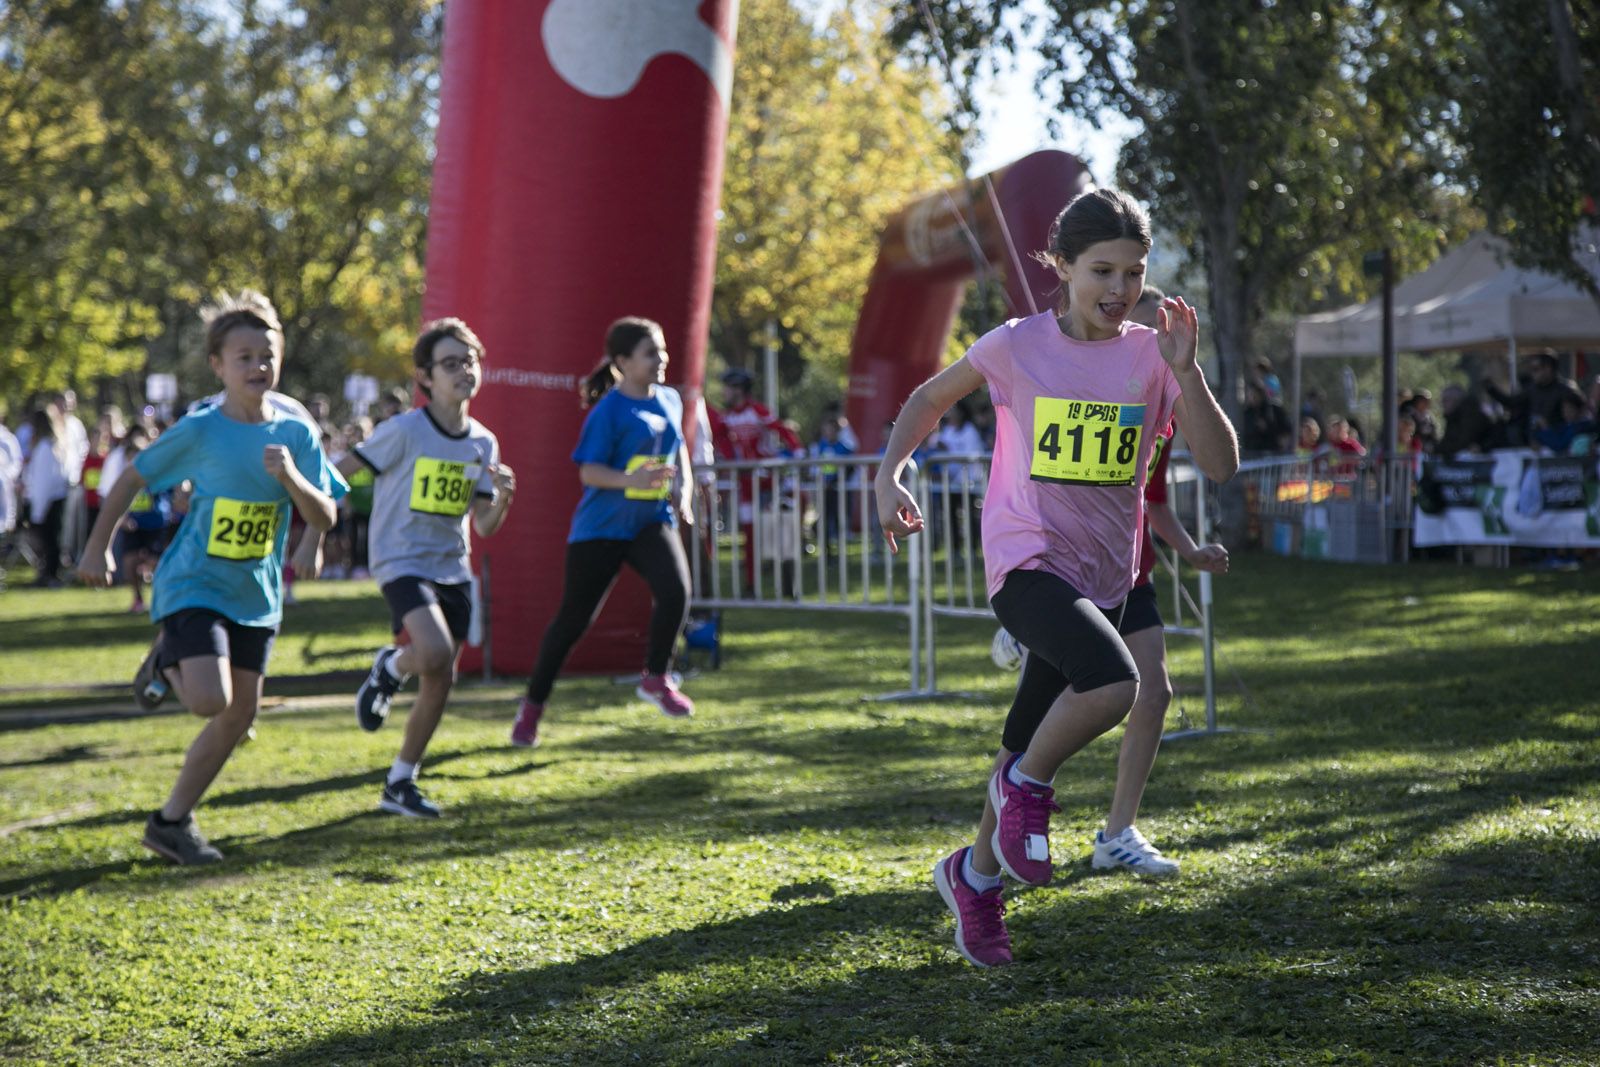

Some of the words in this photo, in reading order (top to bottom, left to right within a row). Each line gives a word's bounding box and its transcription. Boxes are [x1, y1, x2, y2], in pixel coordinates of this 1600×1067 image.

[1067, 402, 1081, 419] 19
[1038, 423, 1137, 465] 4118
[215, 516, 277, 547] 298
